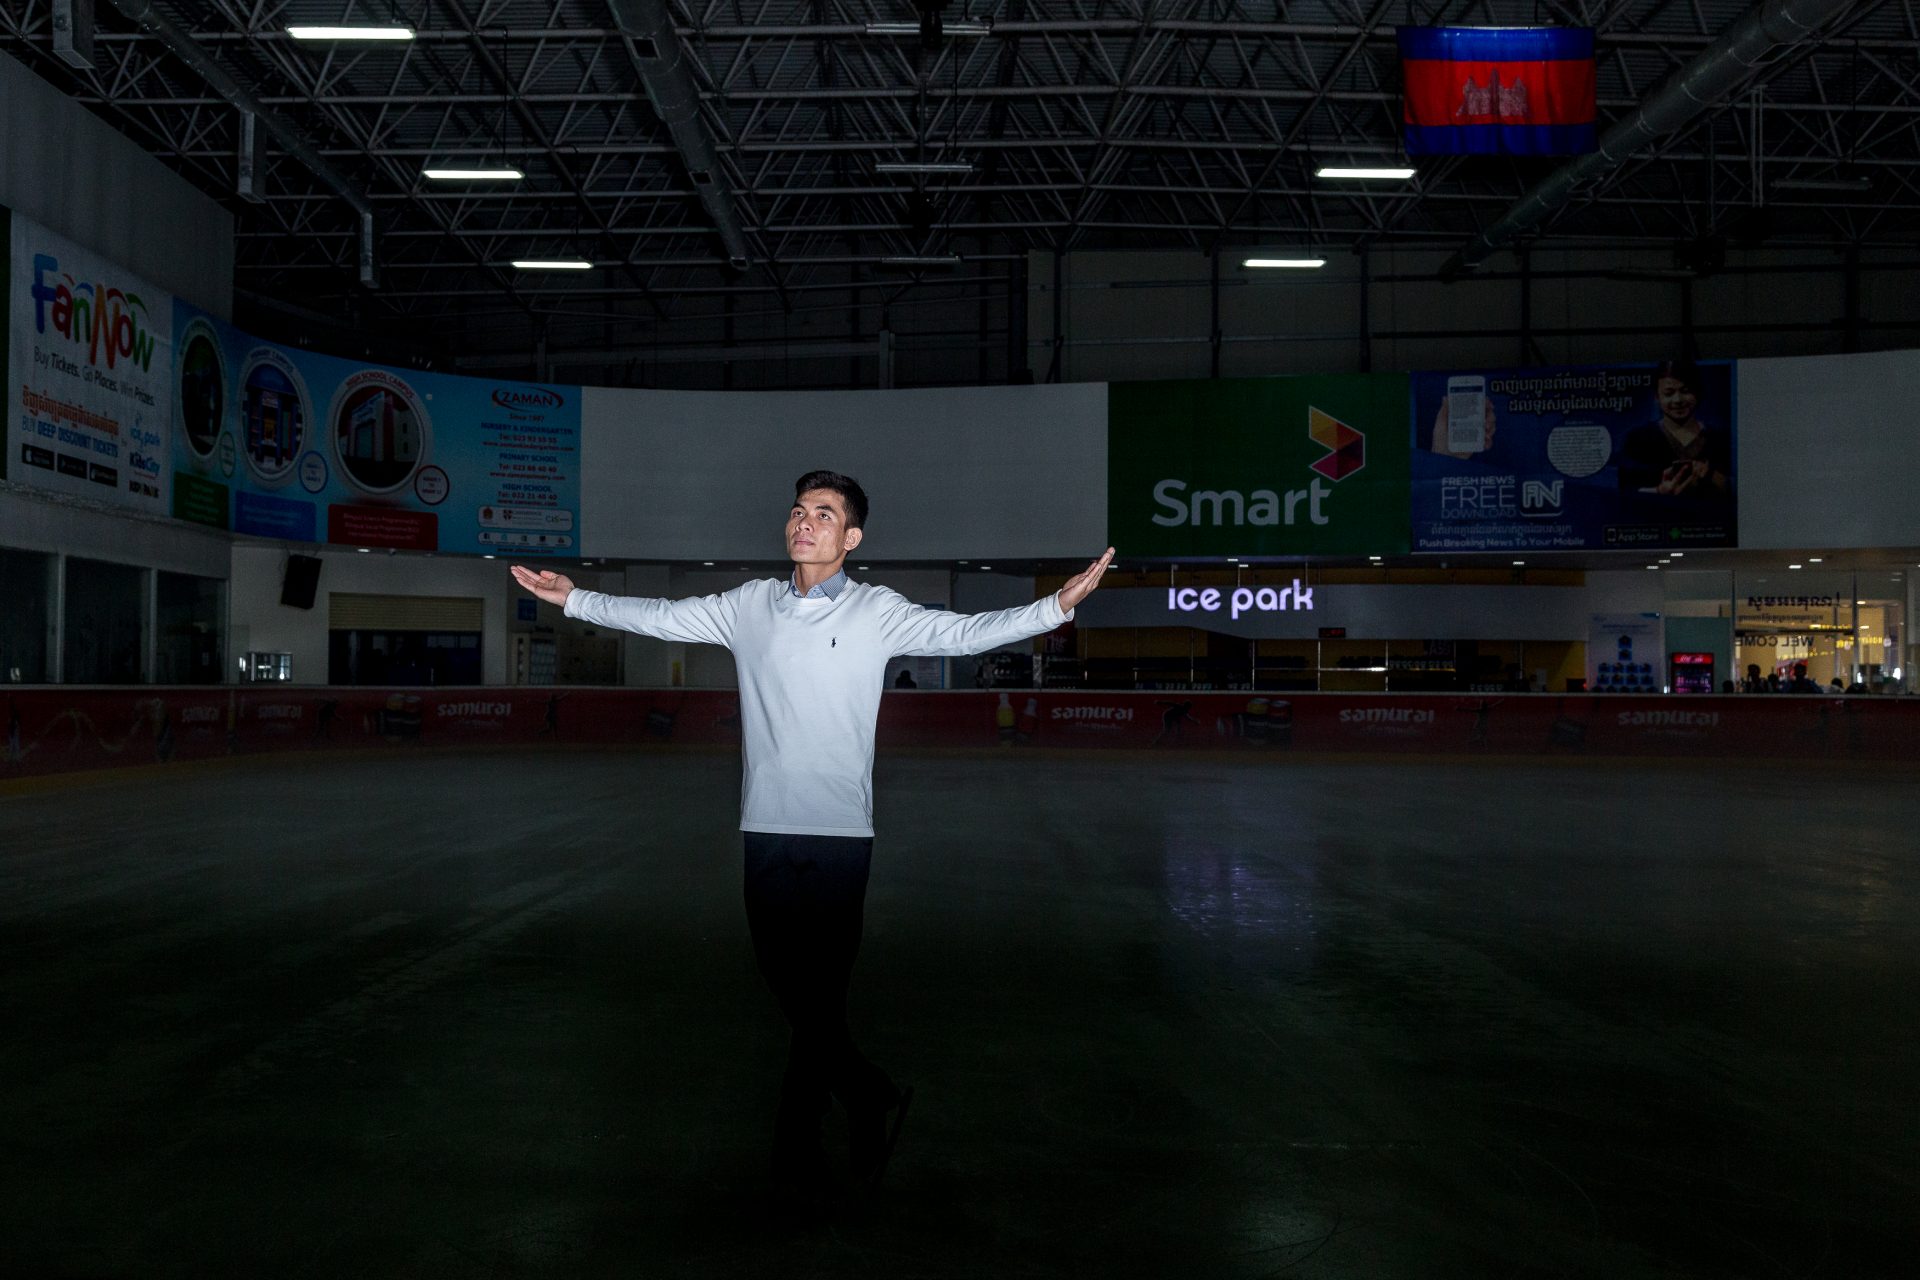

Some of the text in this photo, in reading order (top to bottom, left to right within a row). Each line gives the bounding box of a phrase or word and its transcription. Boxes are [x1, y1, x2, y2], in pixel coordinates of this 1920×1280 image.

[32, 254, 154, 373] FanNow
[34, 346, 49, 369] Buy
[82, 365, 94, 382] Go
[501, 391, 553, 406] ZAMAN
[37, 420, 57, 438] DEEP
[58, 427, 91, 450] DISCOUNT
[499, 452, 559, 463] PRIMARY SCHOOL
[502, 483, 552, 492] HIGH SCHOOL
[1441, 475, 1516, 486] FRESH NEWS
[1151, 476, 1332, 527] Smart
[1441, 485, 1518, 509] FREE
[1440, 508, 1518, 520] DOWNLOAD
[1419, 538, 1443, 548] Push
[1444, 538, 1486, 549] Breaking
[1486, 538, 1514, 547] News
[1515, 537, 1528, 546] To
[1529, 537, 1552, 546] Your
[1168, 578, 1314, 620] ice park
[436, 699, 513, 718] samurai
[1050, 703, 1134, 721] samurai
[1337, 706, 1436, 724] samurai
[1617, 709, 1720, 727] samurai
